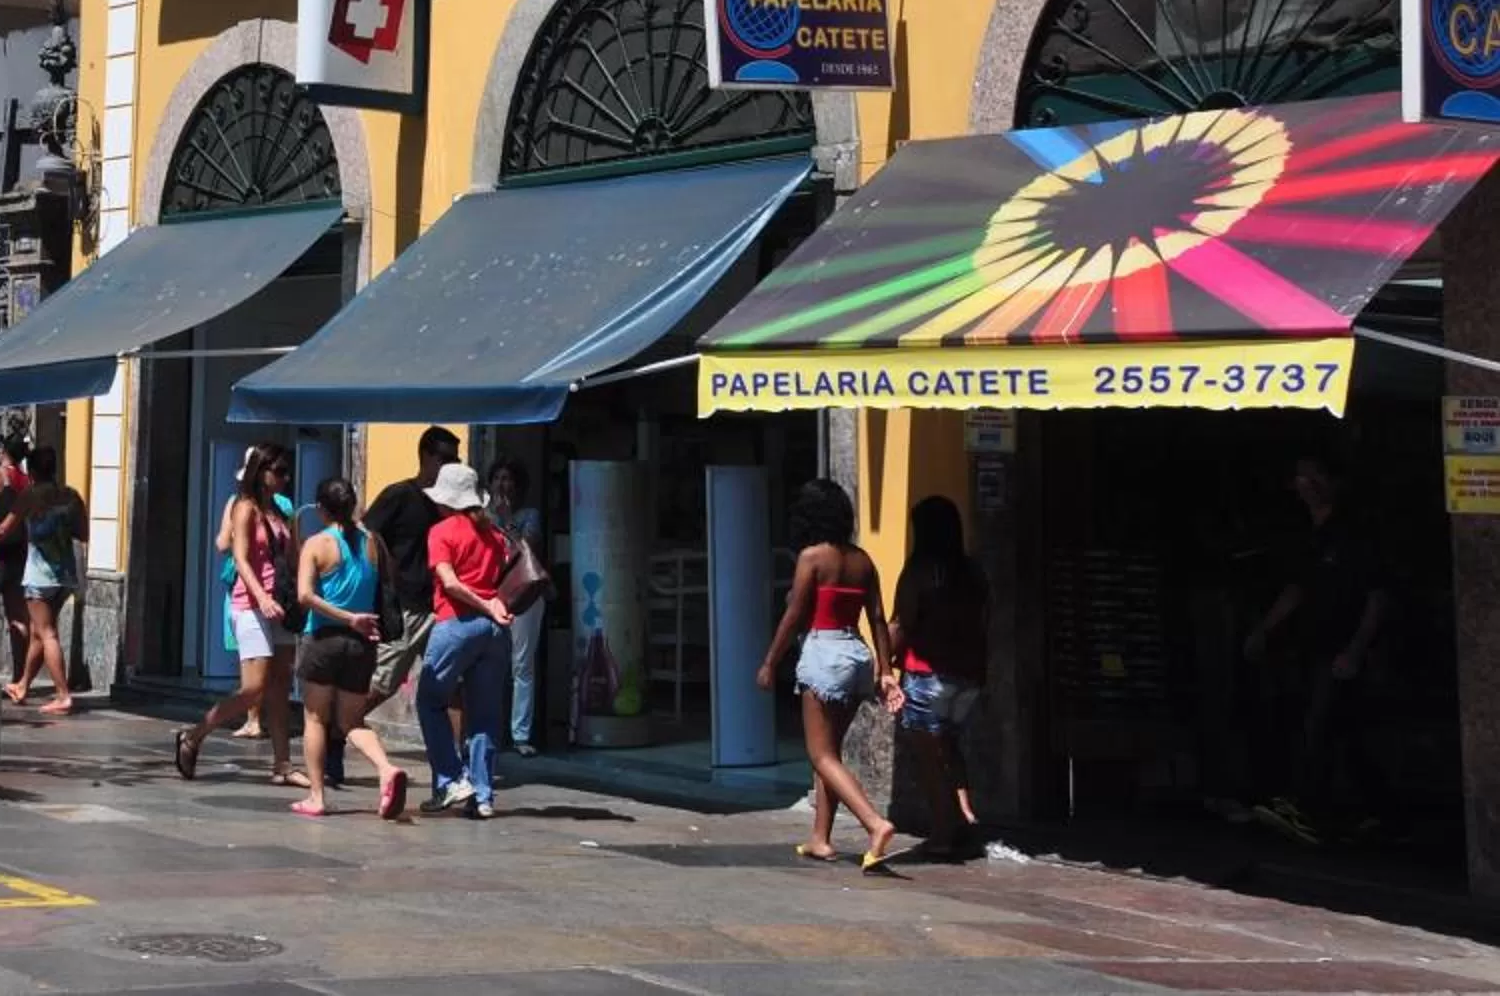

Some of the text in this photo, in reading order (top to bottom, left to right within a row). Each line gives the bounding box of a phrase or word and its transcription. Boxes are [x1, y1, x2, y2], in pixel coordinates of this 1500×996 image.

[795, 26, 886, 50] CATETE
[821, 62, 855, 75] DESDE
[711, 363, 1340, 398] PAPELARIA CATETE 2557-3737
